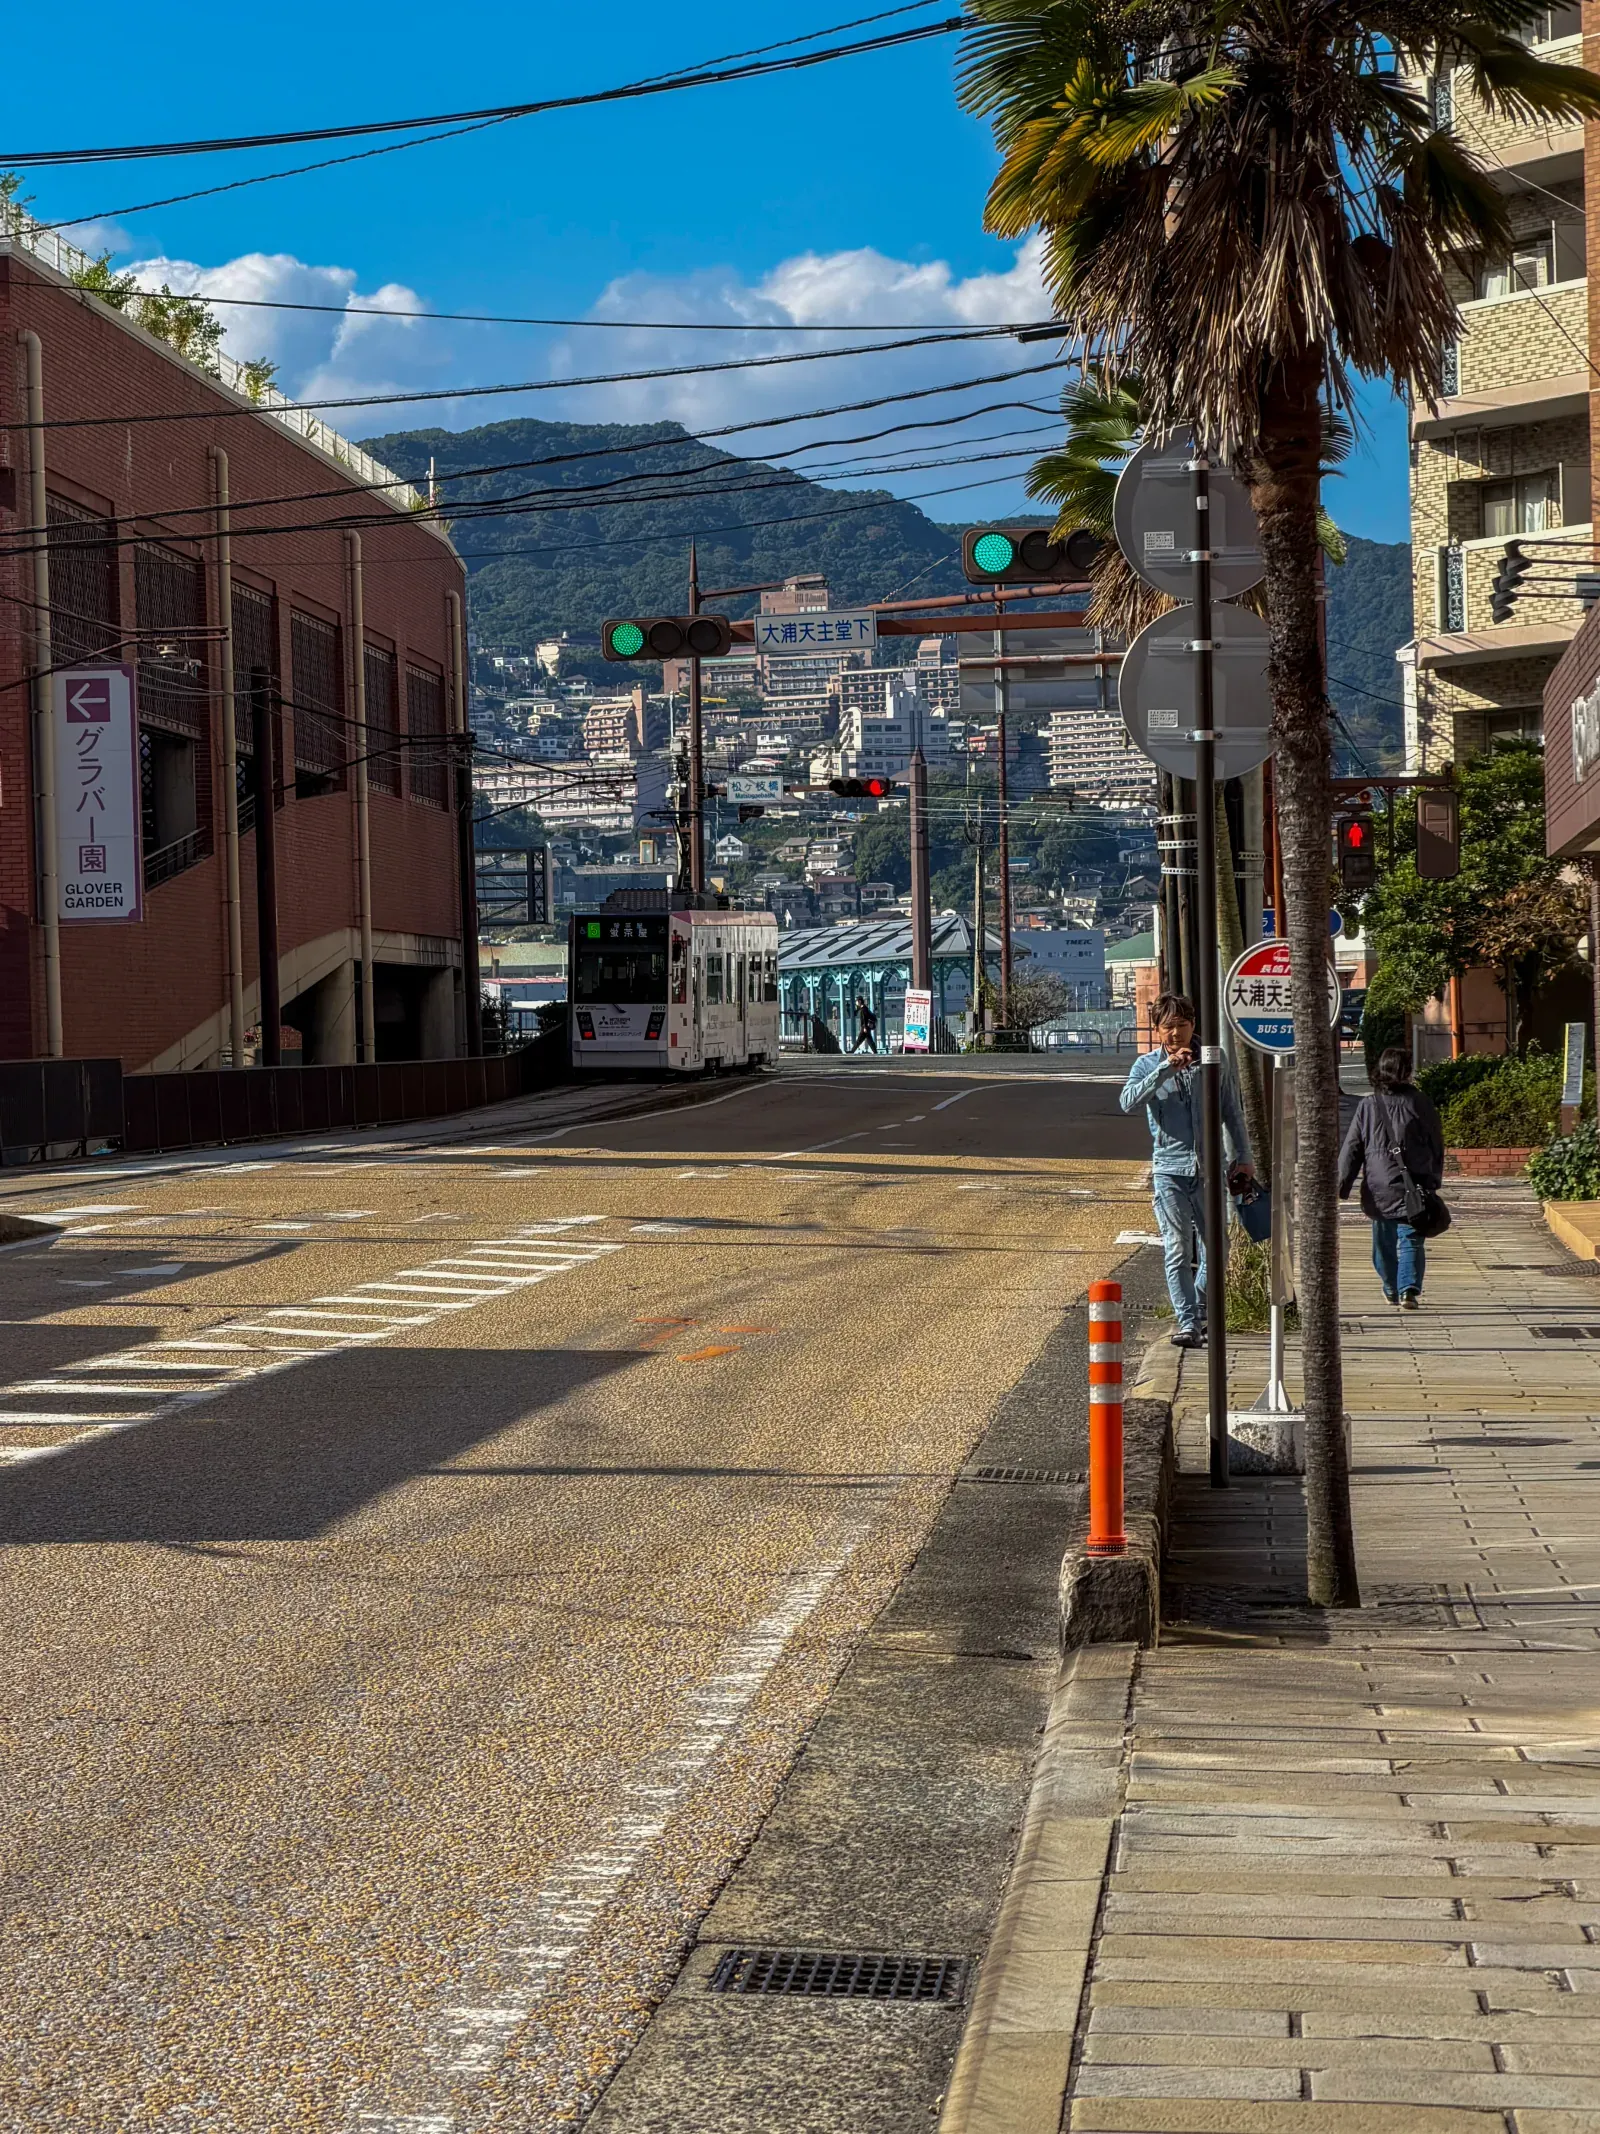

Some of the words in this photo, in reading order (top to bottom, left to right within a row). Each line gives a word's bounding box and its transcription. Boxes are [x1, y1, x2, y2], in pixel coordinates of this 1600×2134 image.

[761, 618, 871, 644] 大浦天主堂下
[731, 780, 779, 792] 松ヶ枝橋
[75, 727, 107, 875] グラバー園
[65, 883, 123, 896] GLOVER
[64, 896, 124, 909] GARDEN
[1064, 938, 1093, 946] TMEIC
[1256, 1024, 1279, 1034] BUS
